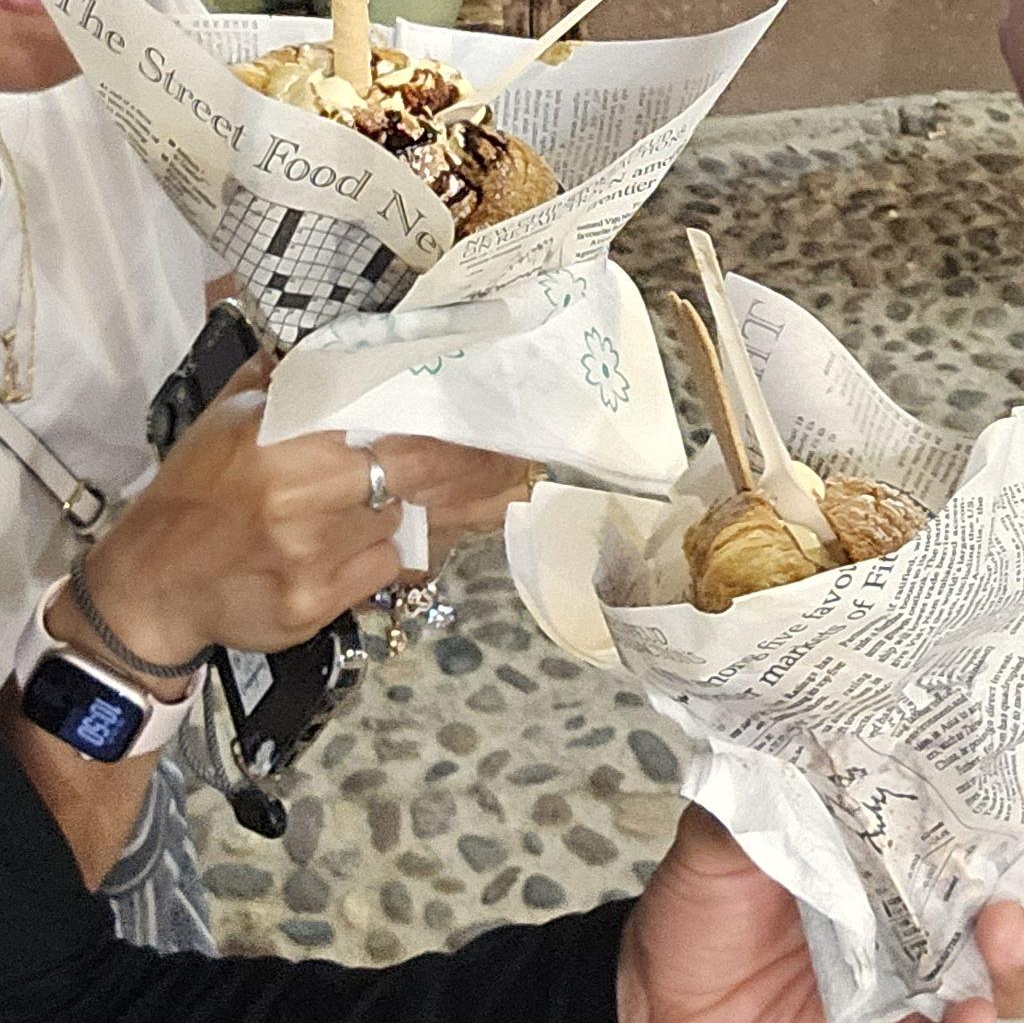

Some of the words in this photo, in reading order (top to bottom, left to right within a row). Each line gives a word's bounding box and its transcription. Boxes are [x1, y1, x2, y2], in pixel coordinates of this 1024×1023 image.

[138, 47, 245, 152] Street
[253, 134, 373, 202] Food
[756, 623, 808, 651] five
[758, 622, 847, 688] markets
[846, 598, 872, 618] of
[76, 698, 123, 748] 10:50
